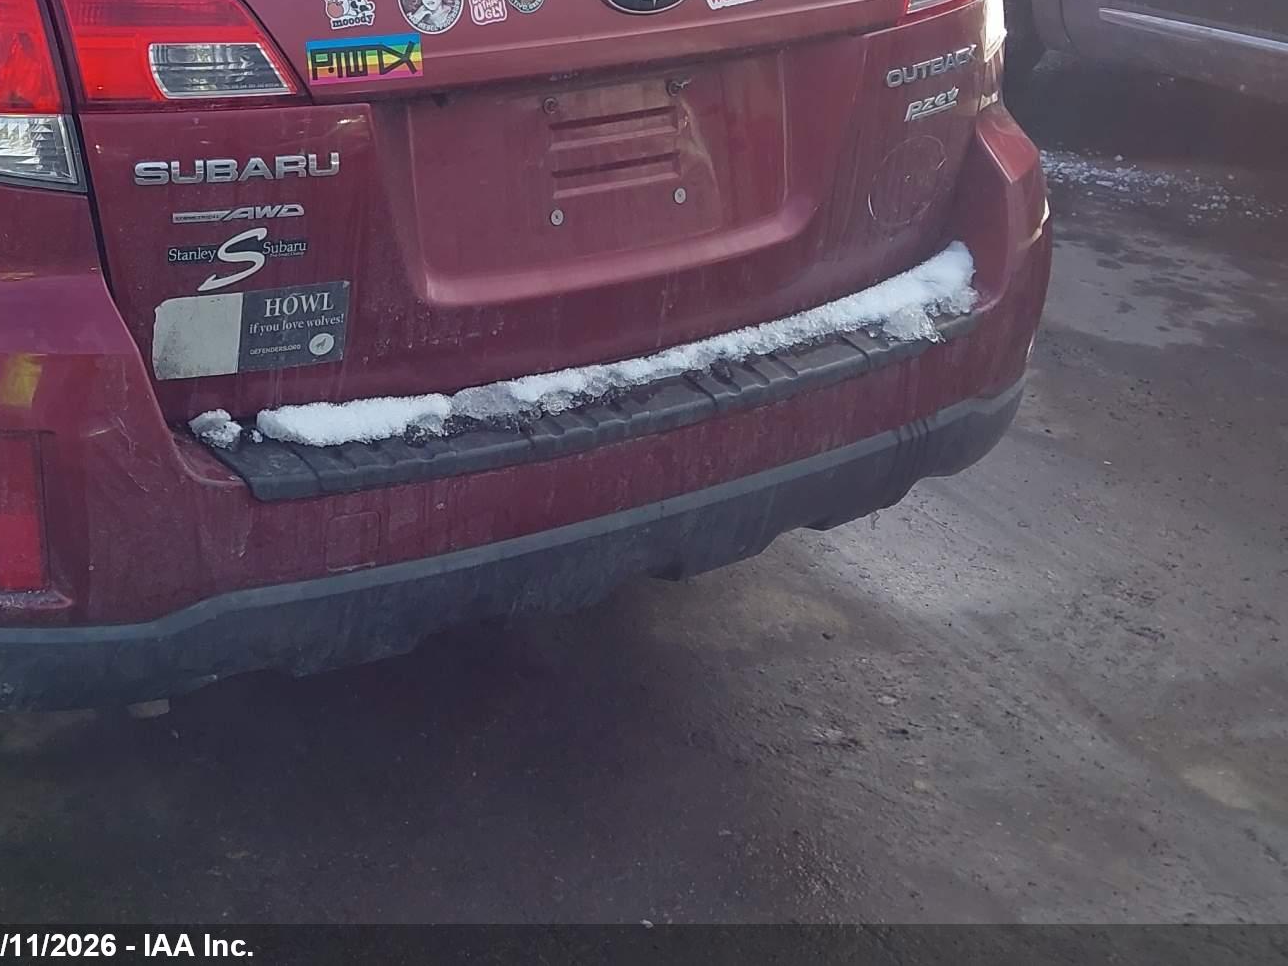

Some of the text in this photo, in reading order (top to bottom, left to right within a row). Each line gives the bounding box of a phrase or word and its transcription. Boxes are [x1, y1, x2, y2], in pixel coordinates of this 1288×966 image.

[332, 13, 374, 28] mooody
[886, 44, 978, 88] OUTBACK
[134, 152, 340, 186] SUBARU
[224, 204, 305, 222] AWD
[168, 247, 217, 264] Stanley
[262, 240, 307, 256] Subaru
[264, 292, 334, 318] HOWL
[249, 313, 344, 336] if you love wolves!
